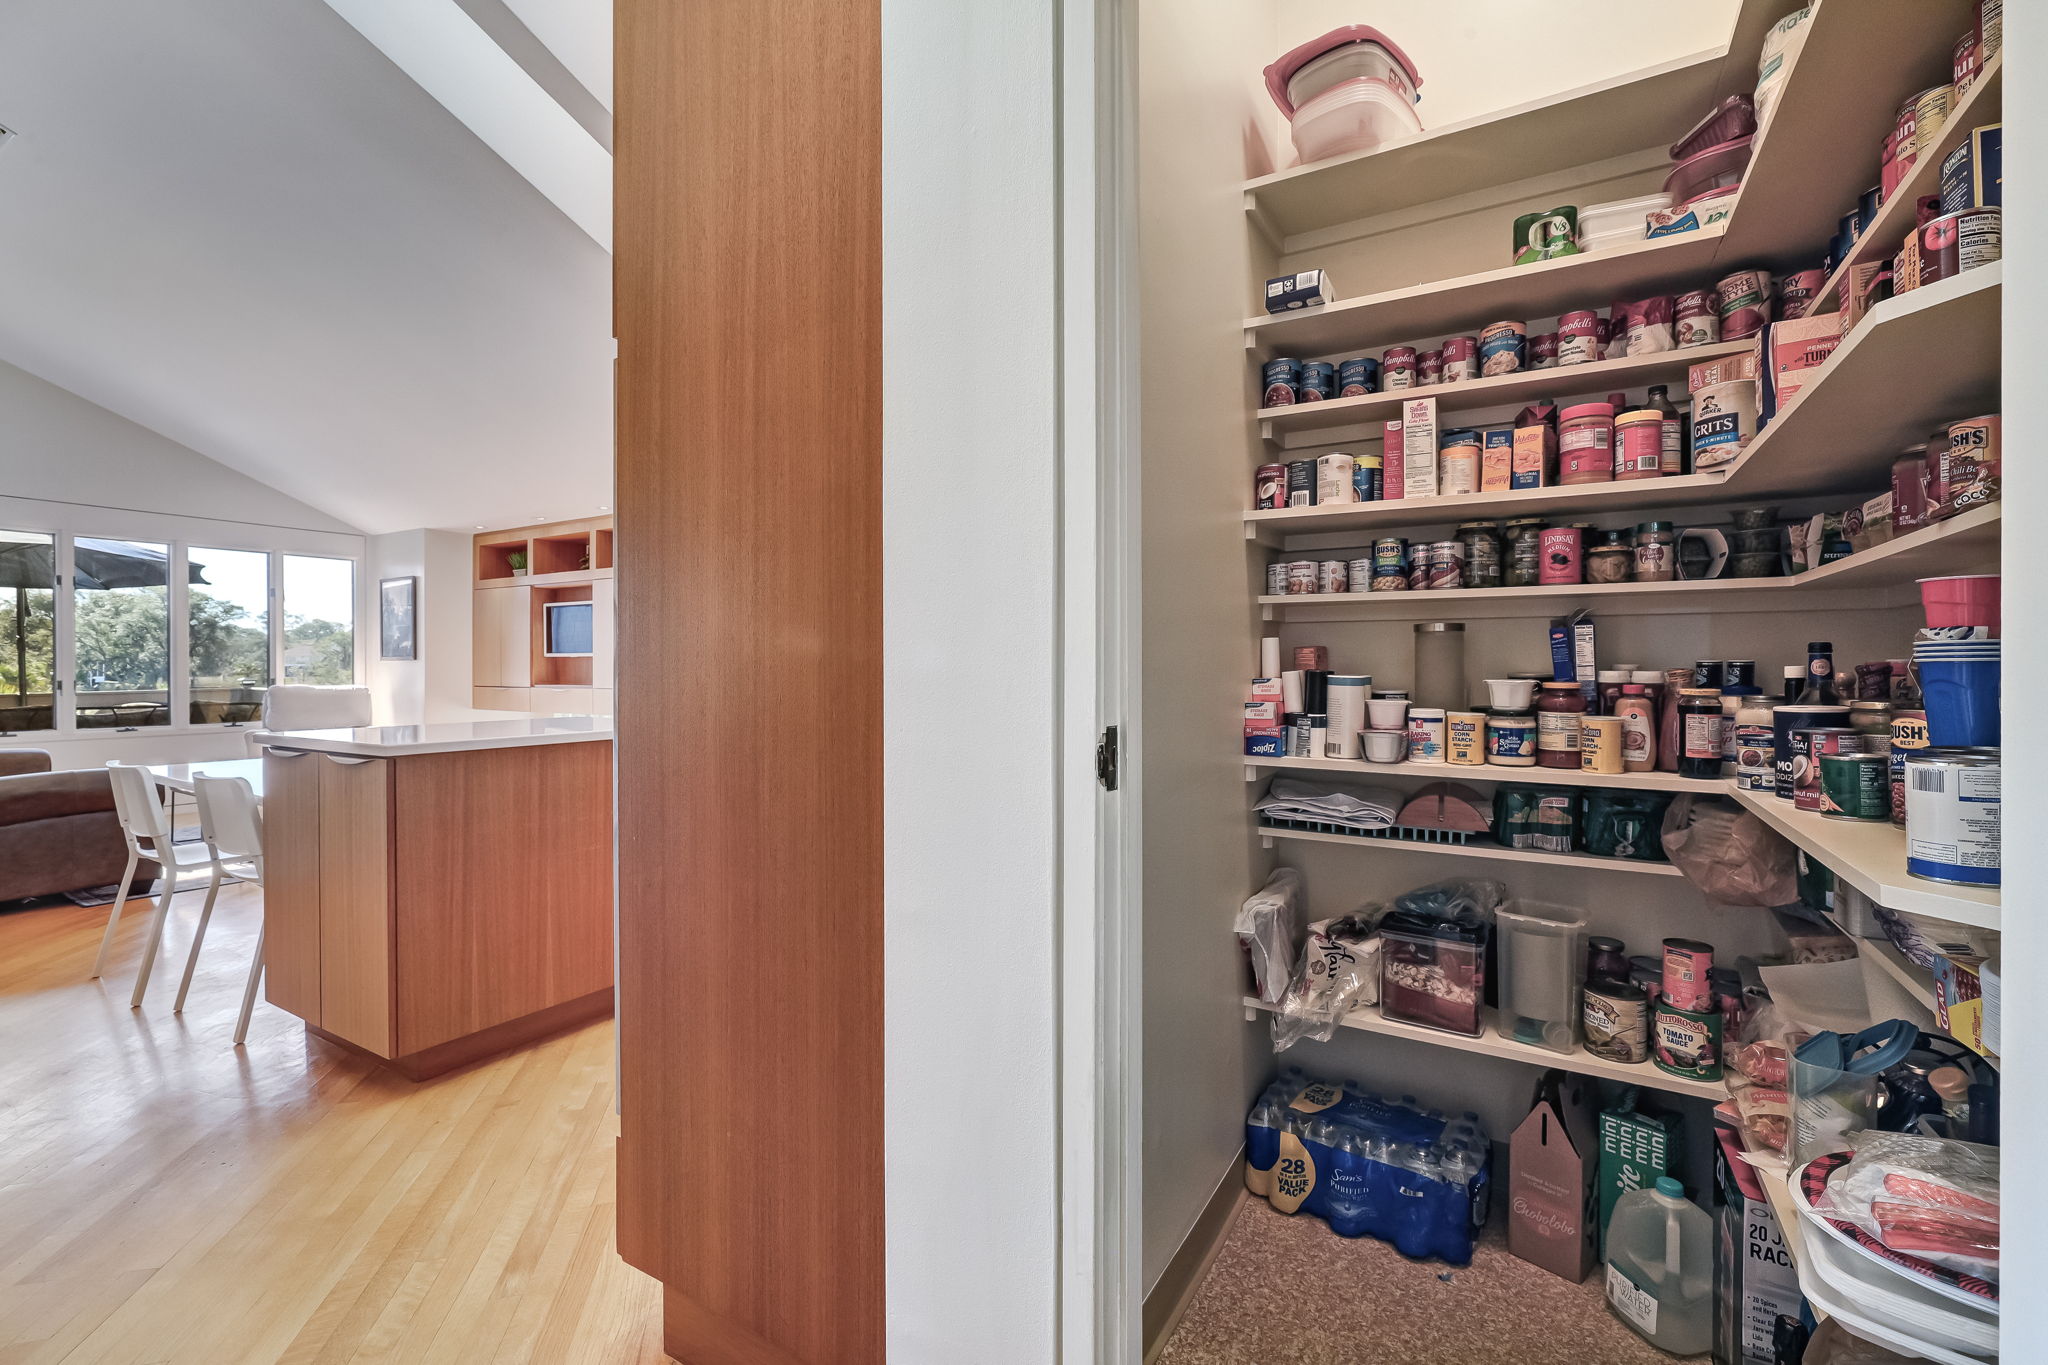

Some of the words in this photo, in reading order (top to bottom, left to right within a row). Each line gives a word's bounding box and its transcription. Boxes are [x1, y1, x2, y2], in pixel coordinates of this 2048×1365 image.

[1553, 220, 1567, 232] V8
[1960, 216, 1989, 226] Nutrition
[1960, 237, 1989, 247] Calories
[1807, 342, 1833, 351] PENNE
[1694, 417, 1734, 438] GRITS
[1544, 534, 1575, 546] LINDSAY
[1376, 545, 1400, 555] BUSH'S
[1547, 545, 1571, 553] MEDIUM
[1252, 742, 1276, 753] Ziploc
[1935, 982, 1949, 1030] GLAD
[1663, 1027, 1694, 1043] TOMATO
[1666, 1037, 1689, 1048] SAUCE
[1974, 1037, 1982, 1050] 50
[1602, 1114, 1617, 1154] mini
[1616, 1119, 1632, 1159] mini
[1631, 1124, 1648, 1165] mini
[1647, 1130, 1664, 1170] mini
[1280, 1158, 1306, 1175] 28
[1278, 1176, 1309, 1191] VALUE
[1278, 1185, 1307, 1198] PACK
[1750, 1223, 1768, 1243] 20
[1611, 1270, 1652, 1307] PURIFIED
[1619, 1286, 1652, 1316] WATER
